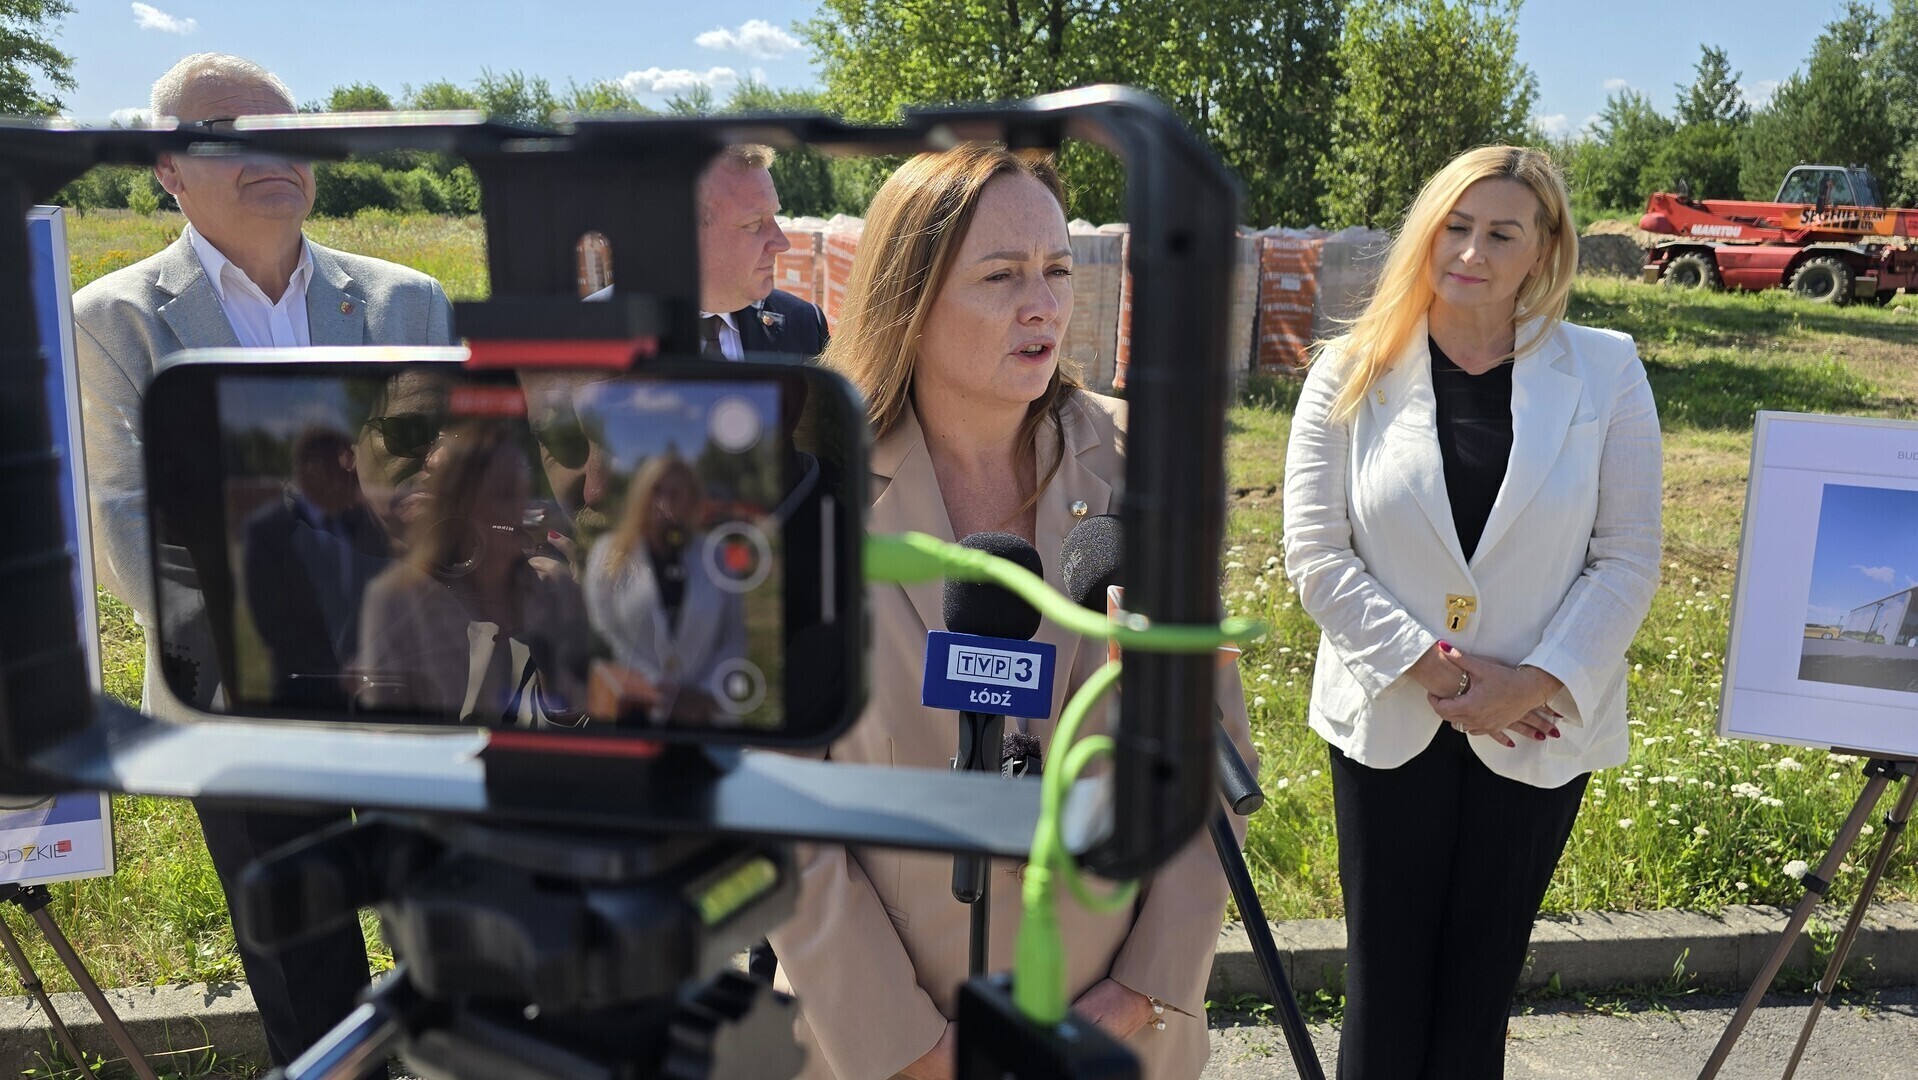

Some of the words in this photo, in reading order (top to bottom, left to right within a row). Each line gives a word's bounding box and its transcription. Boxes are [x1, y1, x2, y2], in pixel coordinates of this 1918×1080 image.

[1690, 223, 1743, 238] MANITOU
[960, 654, 1008, 676] TVP
[1014, 657, 1033, 682] 3
[969, 687, 1012, 707] ŁÓDŹ
